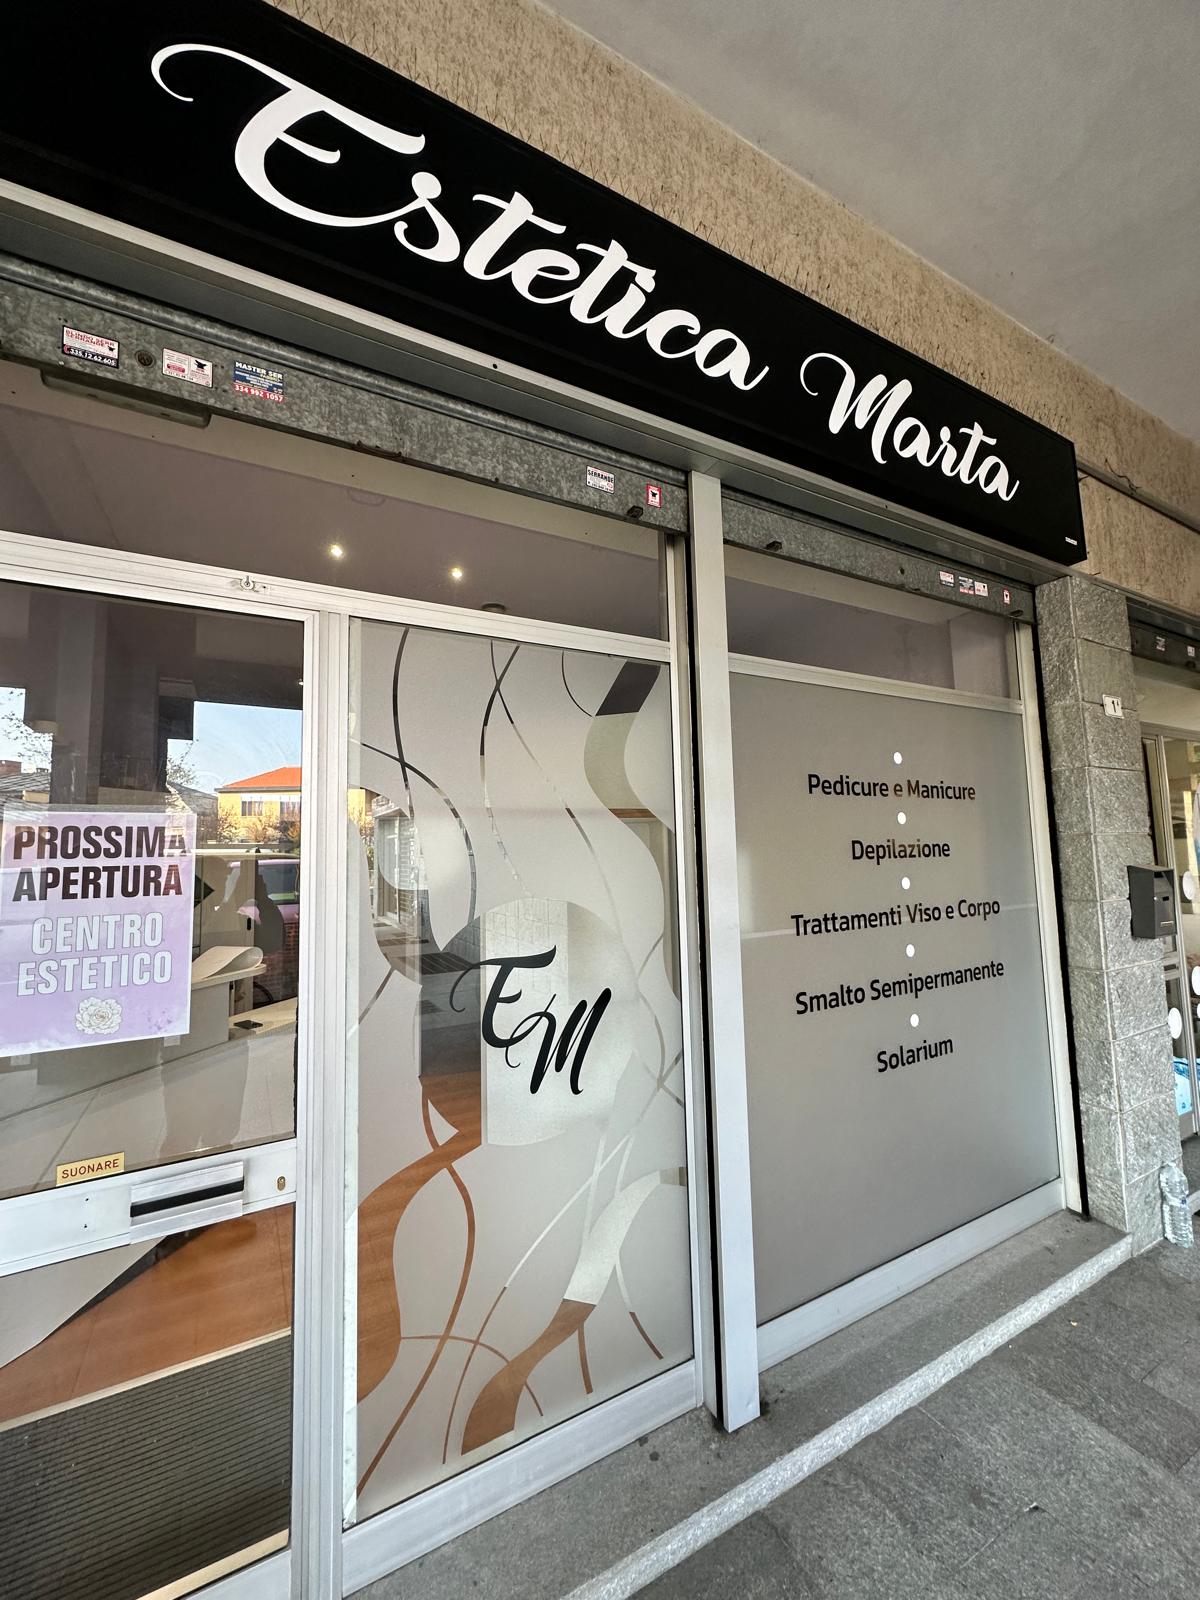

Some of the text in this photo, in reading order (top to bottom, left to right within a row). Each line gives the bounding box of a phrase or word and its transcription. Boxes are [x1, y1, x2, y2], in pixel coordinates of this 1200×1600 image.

[151, 43, 1020, 501] Estetica Marta
[235, 361, 267, 375] MASTER
[807, 773, 976, 801] Pedicure e Manicure
[12, 825, 189, 861] PROSSIMA
[851, 838, 950, 865] Depilazione
[12, 863, 183, 903] APERTURA
[31, 911, 164, 956] CENTRO
[791, 898, 1001, 937] Trattamenti Viso e Corpo
[16, 951, 172, 997] ESTETICO
[795, 960, 1005, 1015] Smalto Semipermanente
[877, 1038, 954, 1073] Solarium
[61, 1158, 120, 1180] SUONARE
